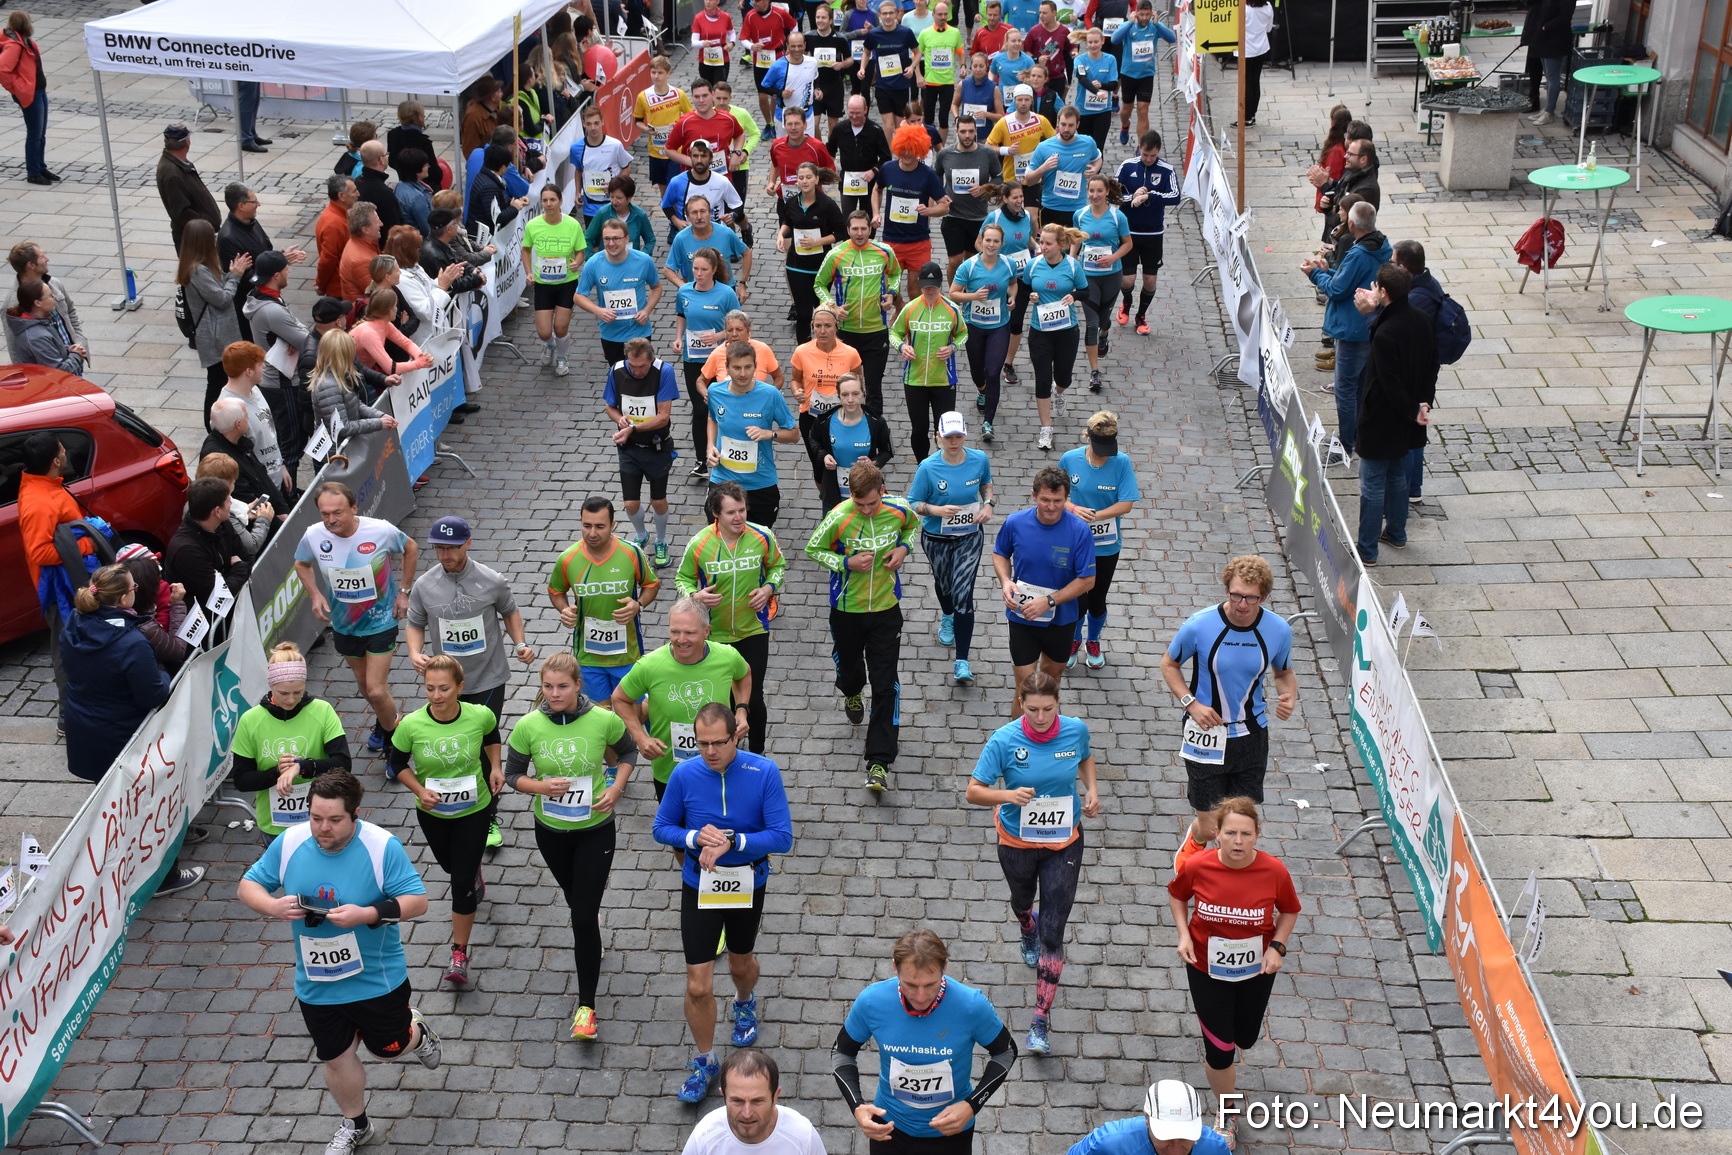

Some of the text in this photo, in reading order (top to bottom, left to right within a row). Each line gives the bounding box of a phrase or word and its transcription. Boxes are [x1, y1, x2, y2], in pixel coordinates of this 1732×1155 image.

[1197, 0, 1239, 9] Jugend
[1210, 11, 1233, 23] lauf
[104, 33, 296, 60] BMW ConnectedDrive
[1135, 47, 1151, 55] 2487
[107, 52, 254, 72] Vernetzt, um frei zu sein.
[1010, 132, 1026, 142] MAX
[850, 180, 860, 188] 85
[956, 177, 976, 186] 2524
[1058, 178, 1078, 188] 2072
[899, 206, 910, 214] 35
[542, 266, 562, 274] 2717
[842, 264, 883, 276] BOCK
[610, 298, 632, 308] 2792
[975, 306, 995, 316] 2451
[1043, 309, 1066, 321] 2370
[910, 321, 952, 332] BOCK
[628, 406, 646, 416] 217
[312, 437, 326, 455] swn
[728, 448, 748, 461] 283
[947, 514, 974, 525] 2588
[440, 524, 454, 536] CG
[1090, 523, 1110, 535] 587
[846, 531, 898, 550] BOCK
[705, 555, 762, 575] BOCK
[336, 578, 366, 590] 2791
[574, 580, 629, 597] BOCK
[260, 570, 304, 644] BOC
[186, 618, 202, 639] swn
[446, 628, 478, 643] 2160
[590, 629, 620, 642] 2781
[1188, 730, 1218, 748] 2701
[1028, 811, 1066, 826] 2447
[712, 880, 740, 892] 302
[1198, 900, 1264, 917] FACKELMANN
[1228, 918, 1248, 926] KÜCHE
[310, 948, 352, 965] 2108
[1216, 950, 1256, 965] 2470
[51, 976, 104, 1062] Service-Line:
[103, 966, 110, 979] 0
[1502, 1019, 1510, 1036] die
[1504, 999, 1528, 1048] Neumarkts
[883, 1044, 953, 1056] www.hasit.de
[898, 1076, 943, 1092] 2377
